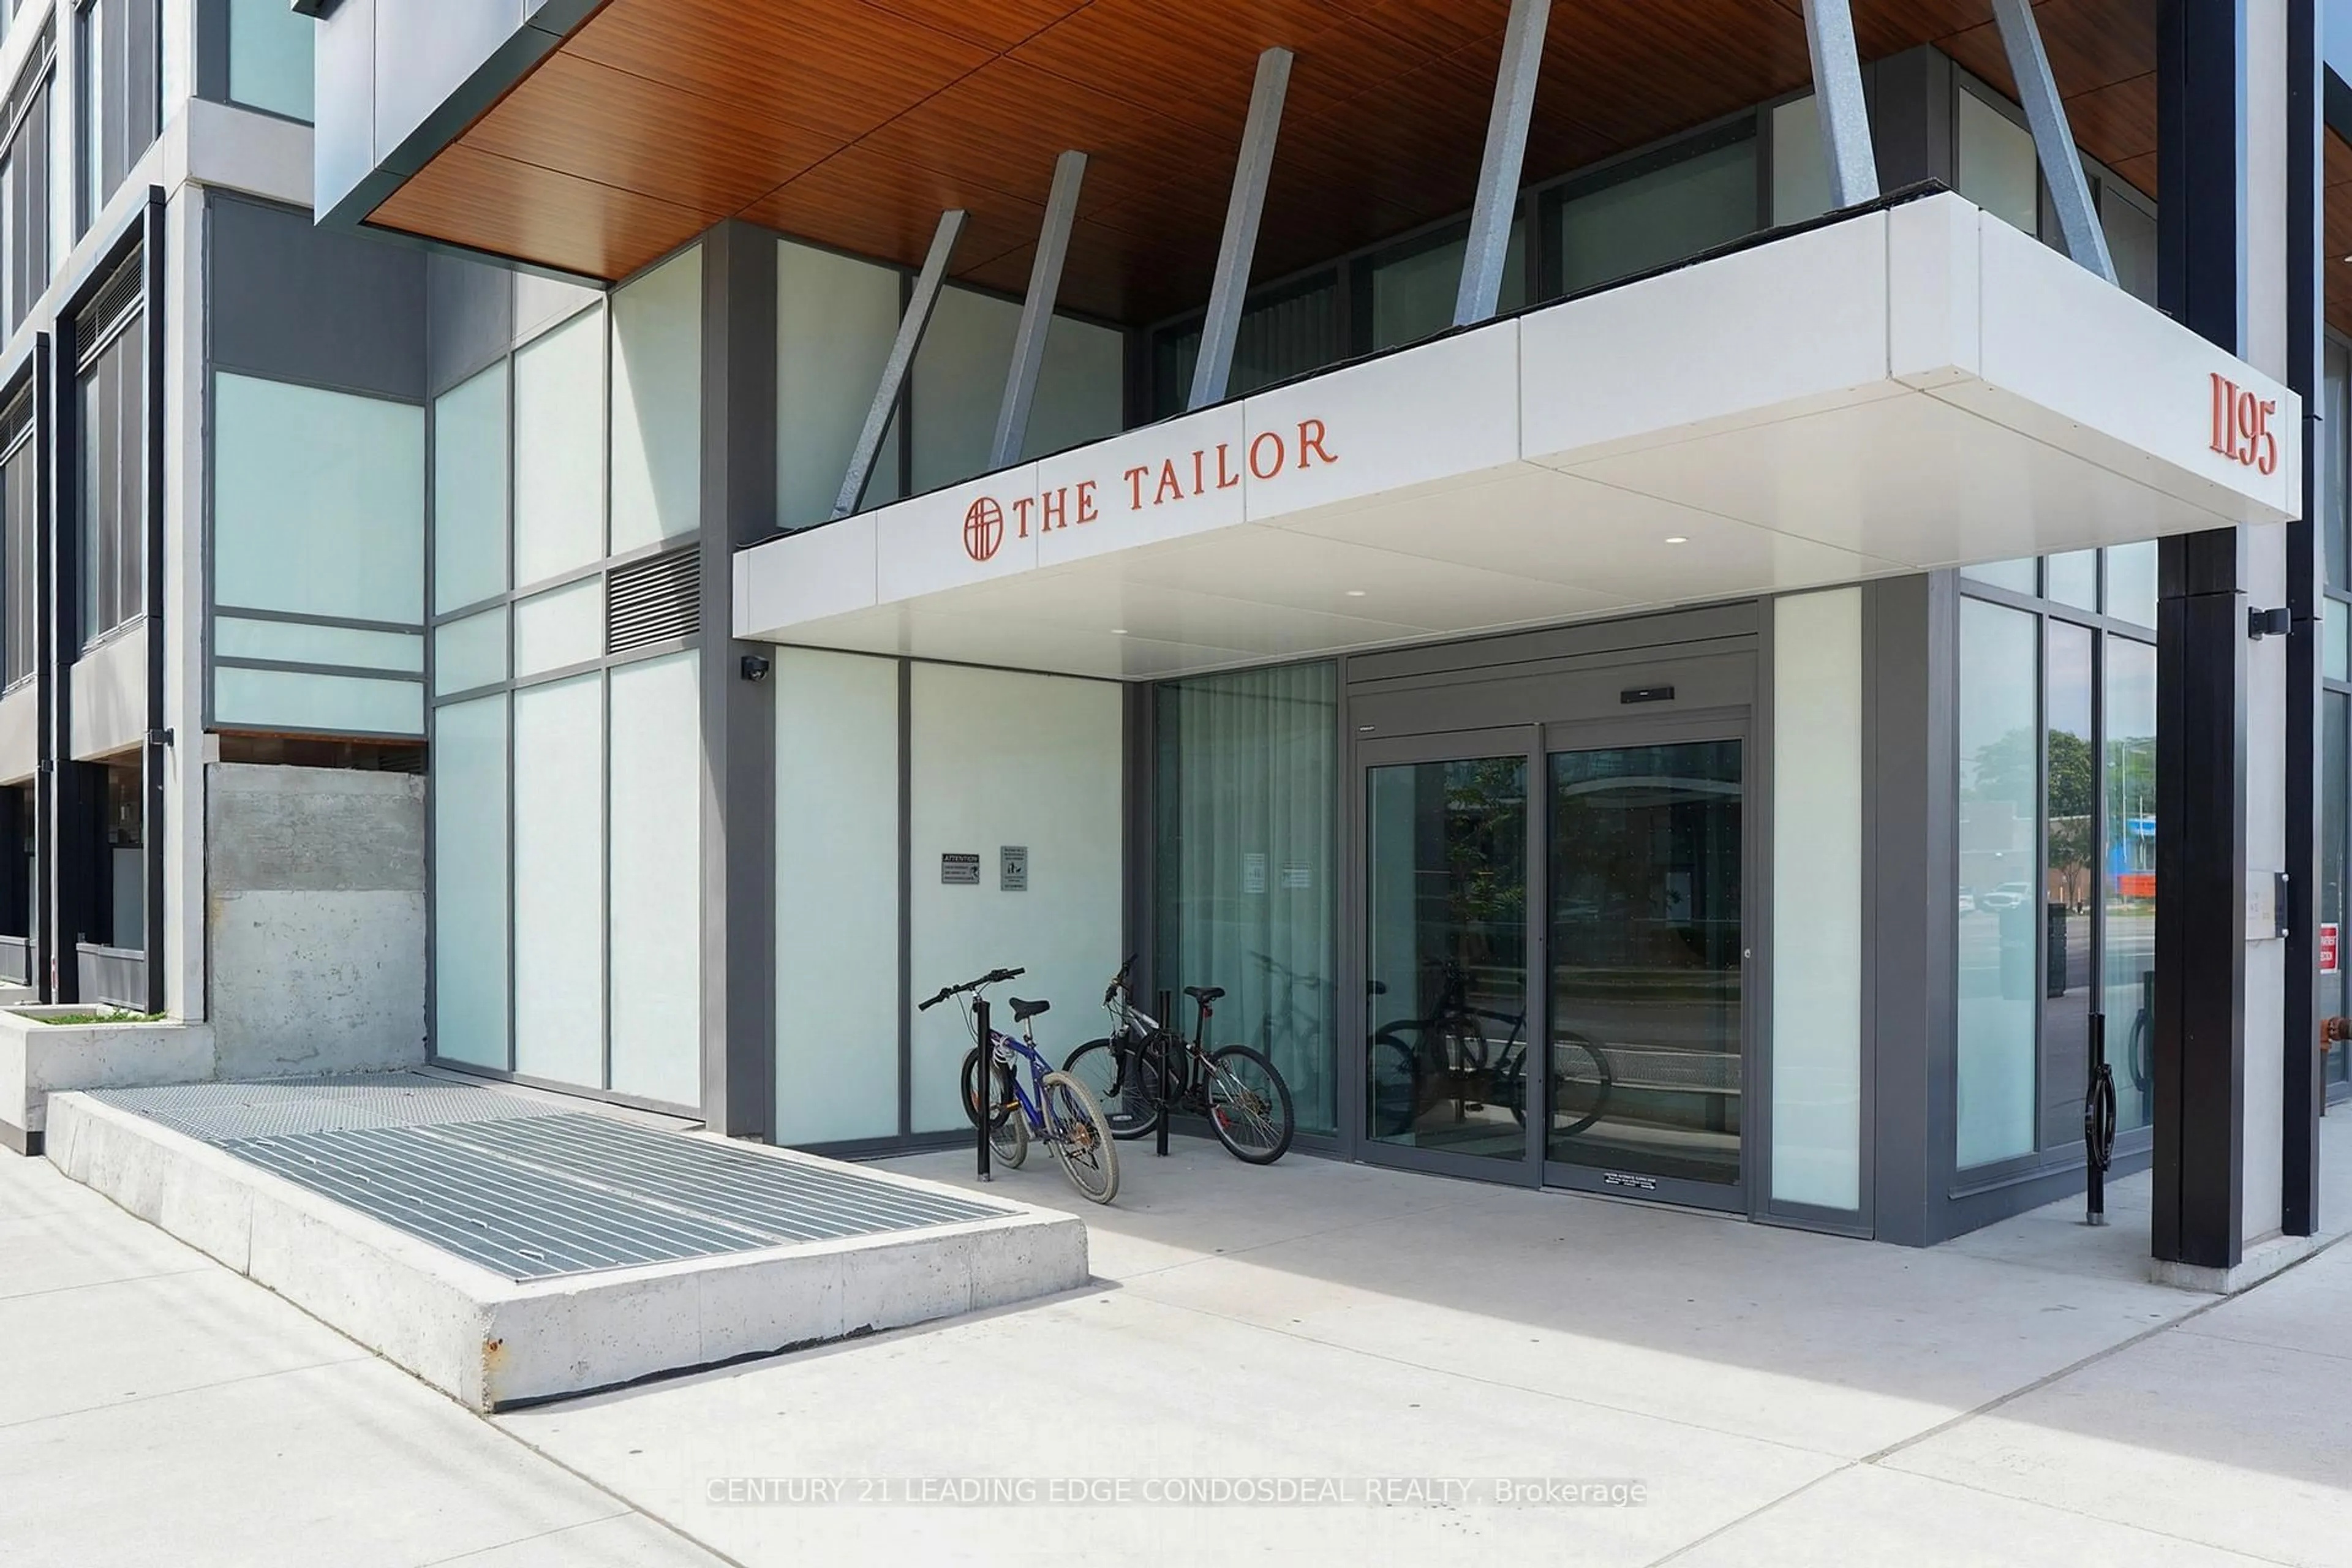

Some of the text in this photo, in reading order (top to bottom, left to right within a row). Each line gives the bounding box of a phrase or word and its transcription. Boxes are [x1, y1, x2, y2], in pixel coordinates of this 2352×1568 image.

[1013, 419, 1339, 538] THE TAILOR
[2210, 372, 2277, 475] 1195
